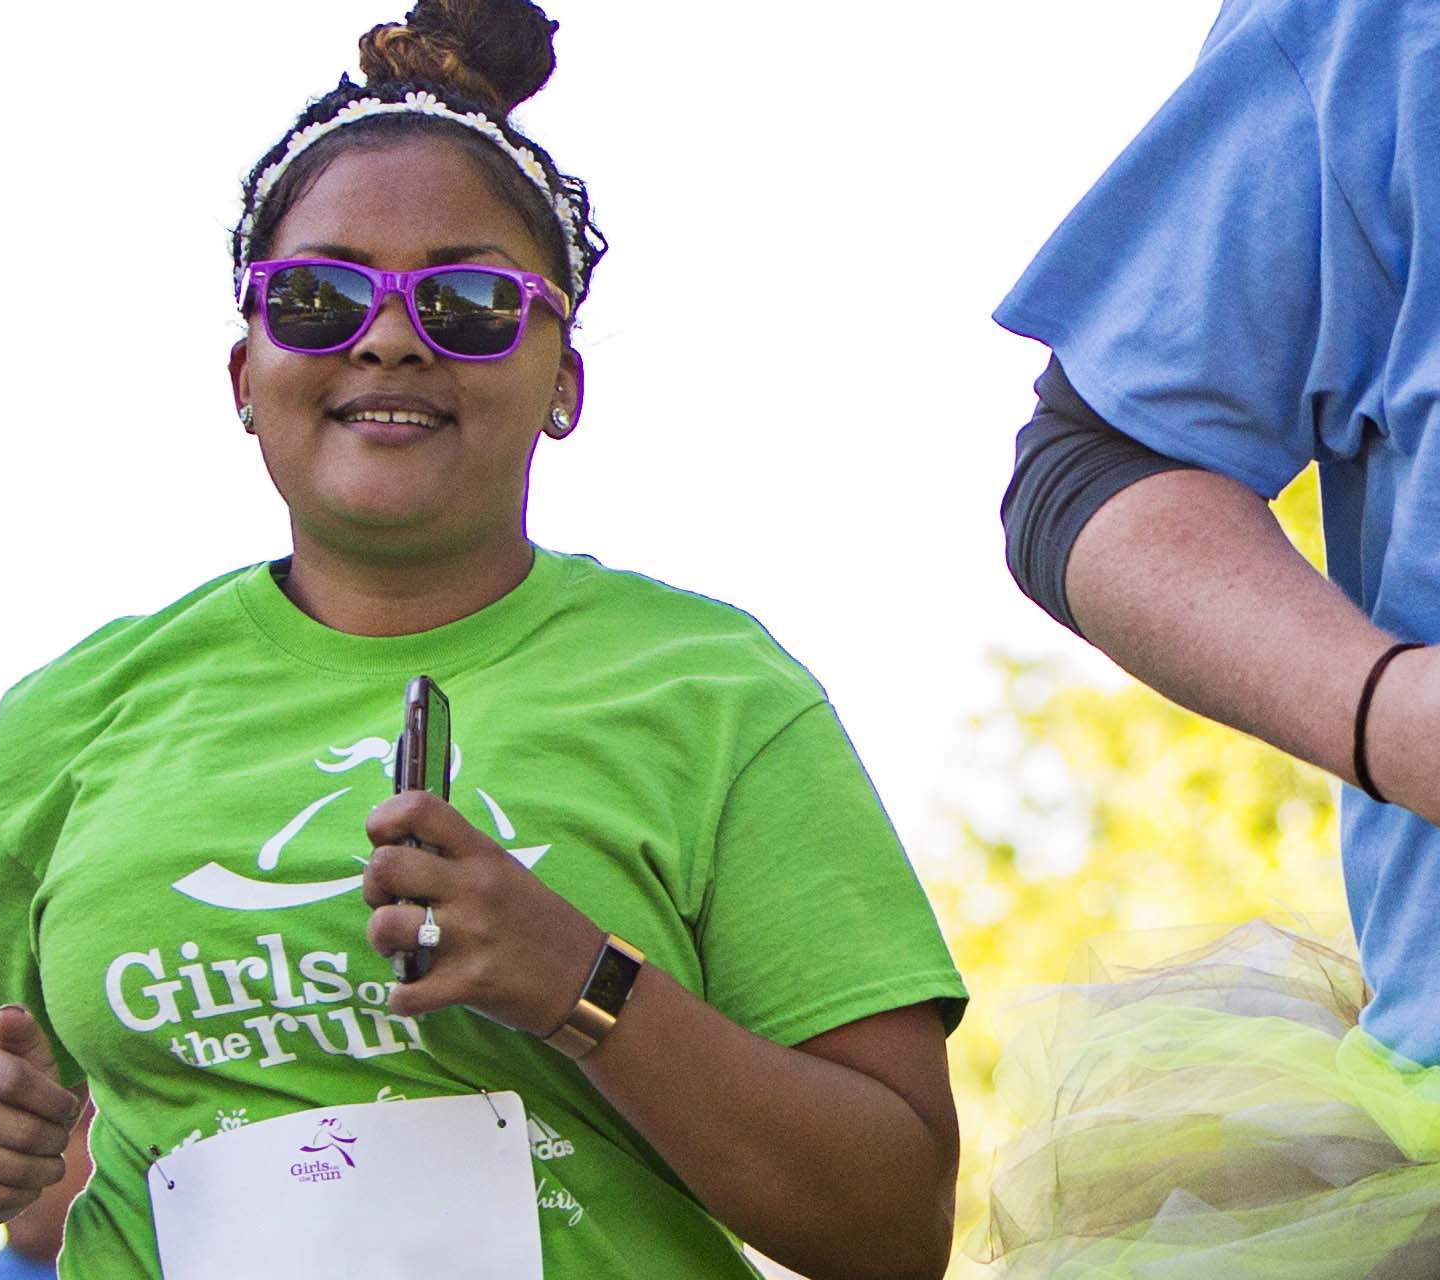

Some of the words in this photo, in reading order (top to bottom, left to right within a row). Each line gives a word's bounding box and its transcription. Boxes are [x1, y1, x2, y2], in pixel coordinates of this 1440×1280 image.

[105, 933, 353, 1032] Girls
[169, 1031, 252, 1068] the
[244, 1006, 434, 1068] run
[290, 1160, 329, 1176] Girls
[312, 1170, 342, 1182] run
